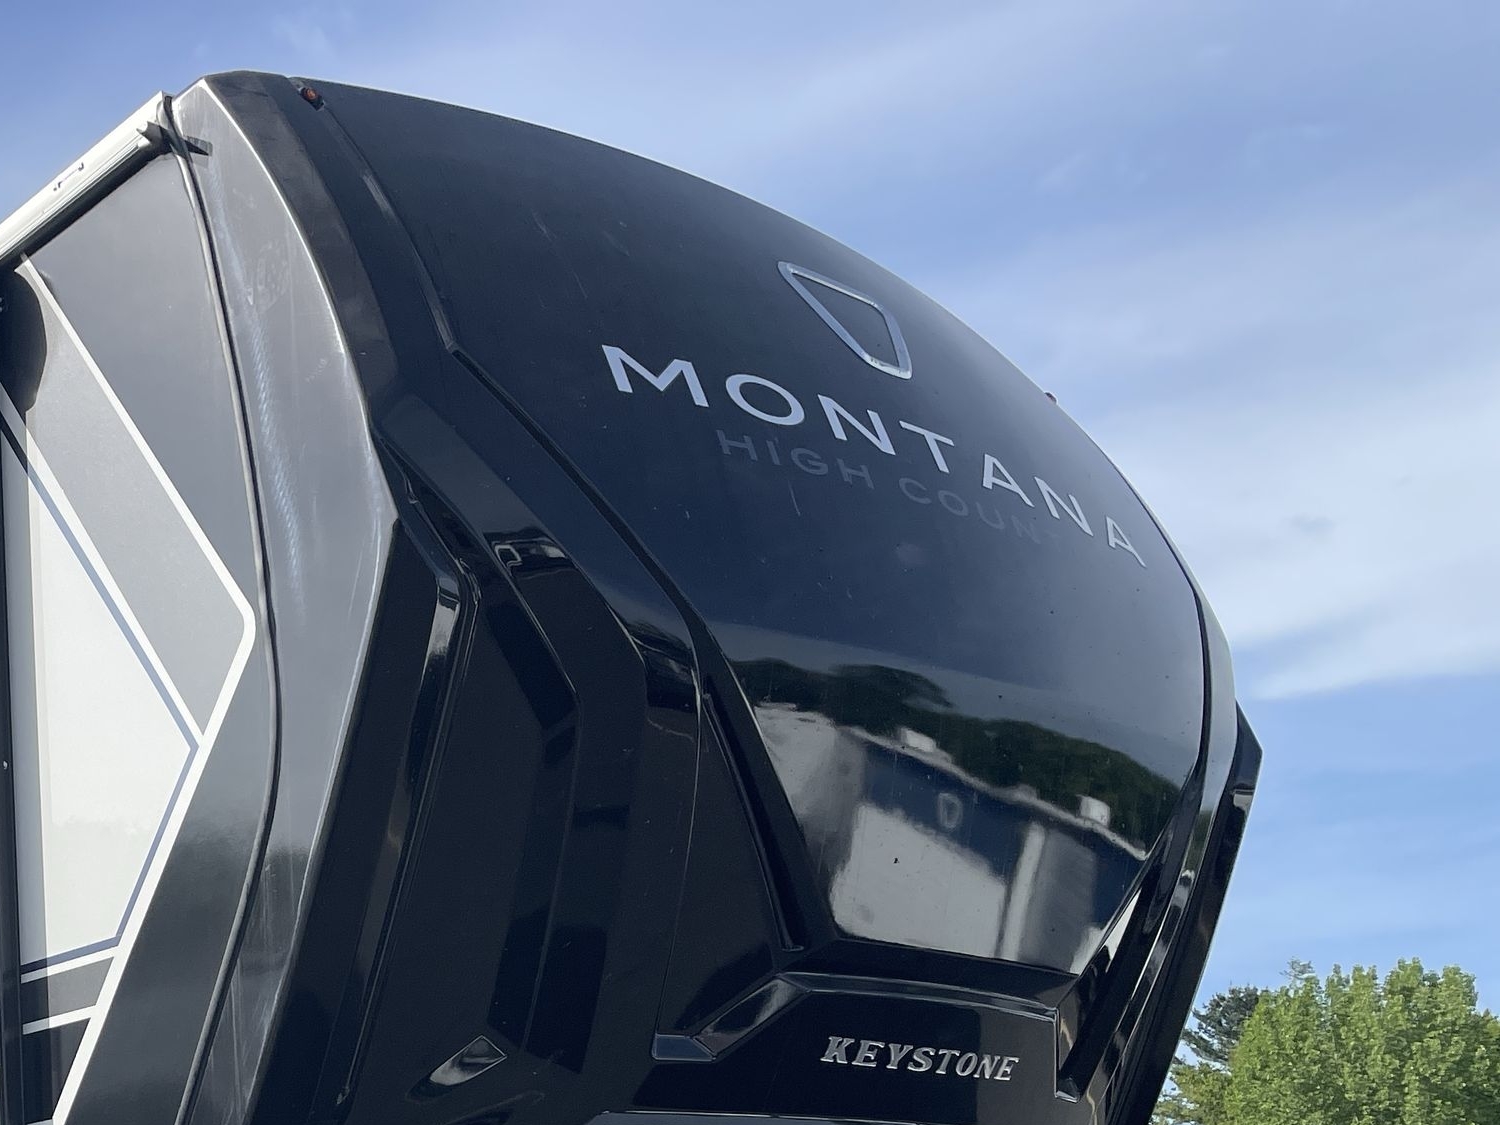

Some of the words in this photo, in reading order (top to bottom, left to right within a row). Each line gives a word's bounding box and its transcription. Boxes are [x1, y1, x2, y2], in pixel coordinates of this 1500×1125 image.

[600, 343, 1147, 568] MONTANA
[716, 429, 875, 490] HIGH
[819, 1035, 1020, 1082] KEYSTONE
